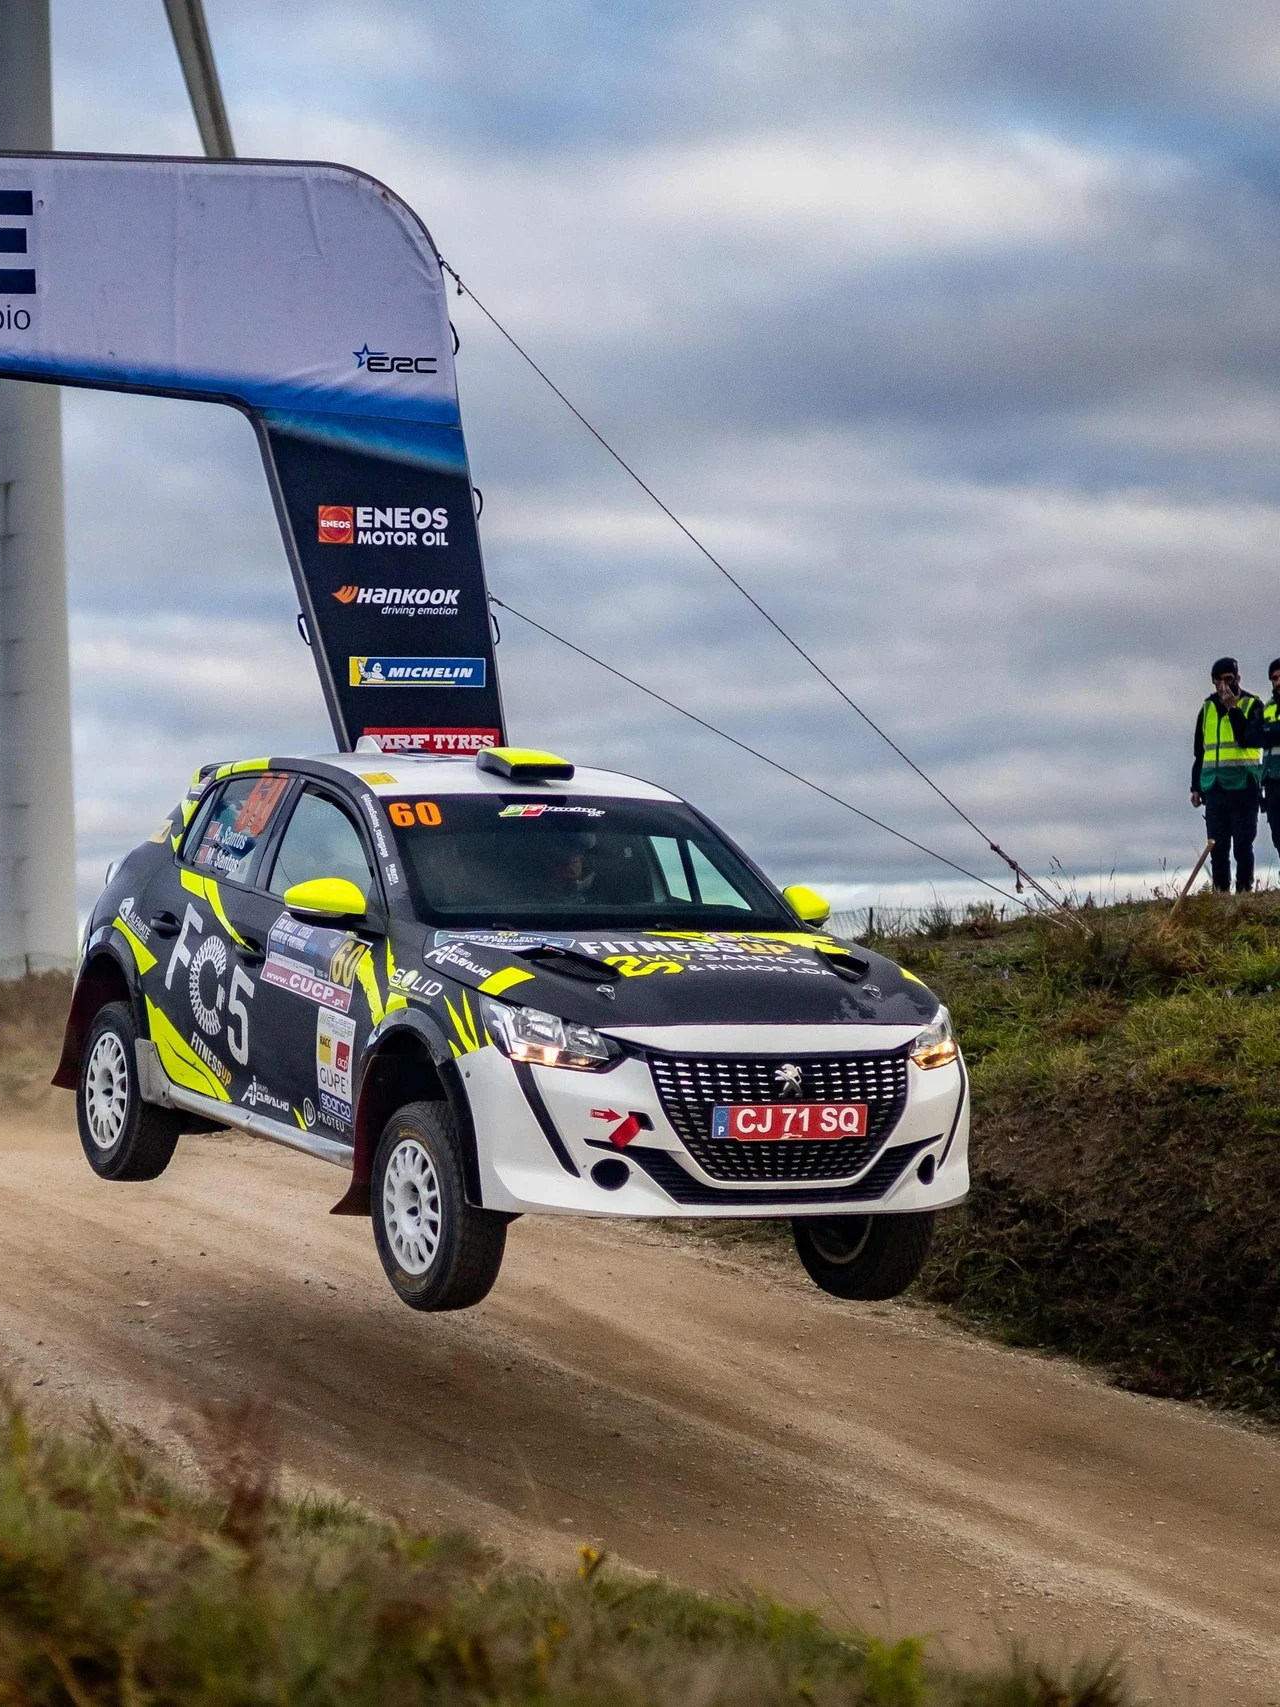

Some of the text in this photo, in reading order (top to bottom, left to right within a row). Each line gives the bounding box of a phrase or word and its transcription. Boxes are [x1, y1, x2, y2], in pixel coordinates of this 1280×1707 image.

[367, 357, 438, 374] ERC
[320, 519, 351, 530] ENEOS
[356, 506, 449, 530] ENEOS
[357, 531, 449, 546] MOTOR OIL
[381, 606, 458, 617] driving emotion
[387, 667, 474, 679] MICHELIN
[433, 734, 495, 750] TYRES
[388, 801, 443, 827] 60
[221, 825, 248, 850] Santos
[214, 849, 240, 873] Santos
[332, 940, 366, 988] 60
[689, 964, 704, 972] &
[709, 963, 788, 973] FILHOS
[702, 953, 819, 967] SANTOS
[266, 970, 346, 1008] www.CUCP.pt
[390, 968, 443, 997] SOLID
[321, 1093, 351, 1119] sparco
[317, 1111, 345, 1132] PROTEU
[736, 1107, 859, 1133] CJ 71 SQ
[717, 1126, 725, 1136] P
